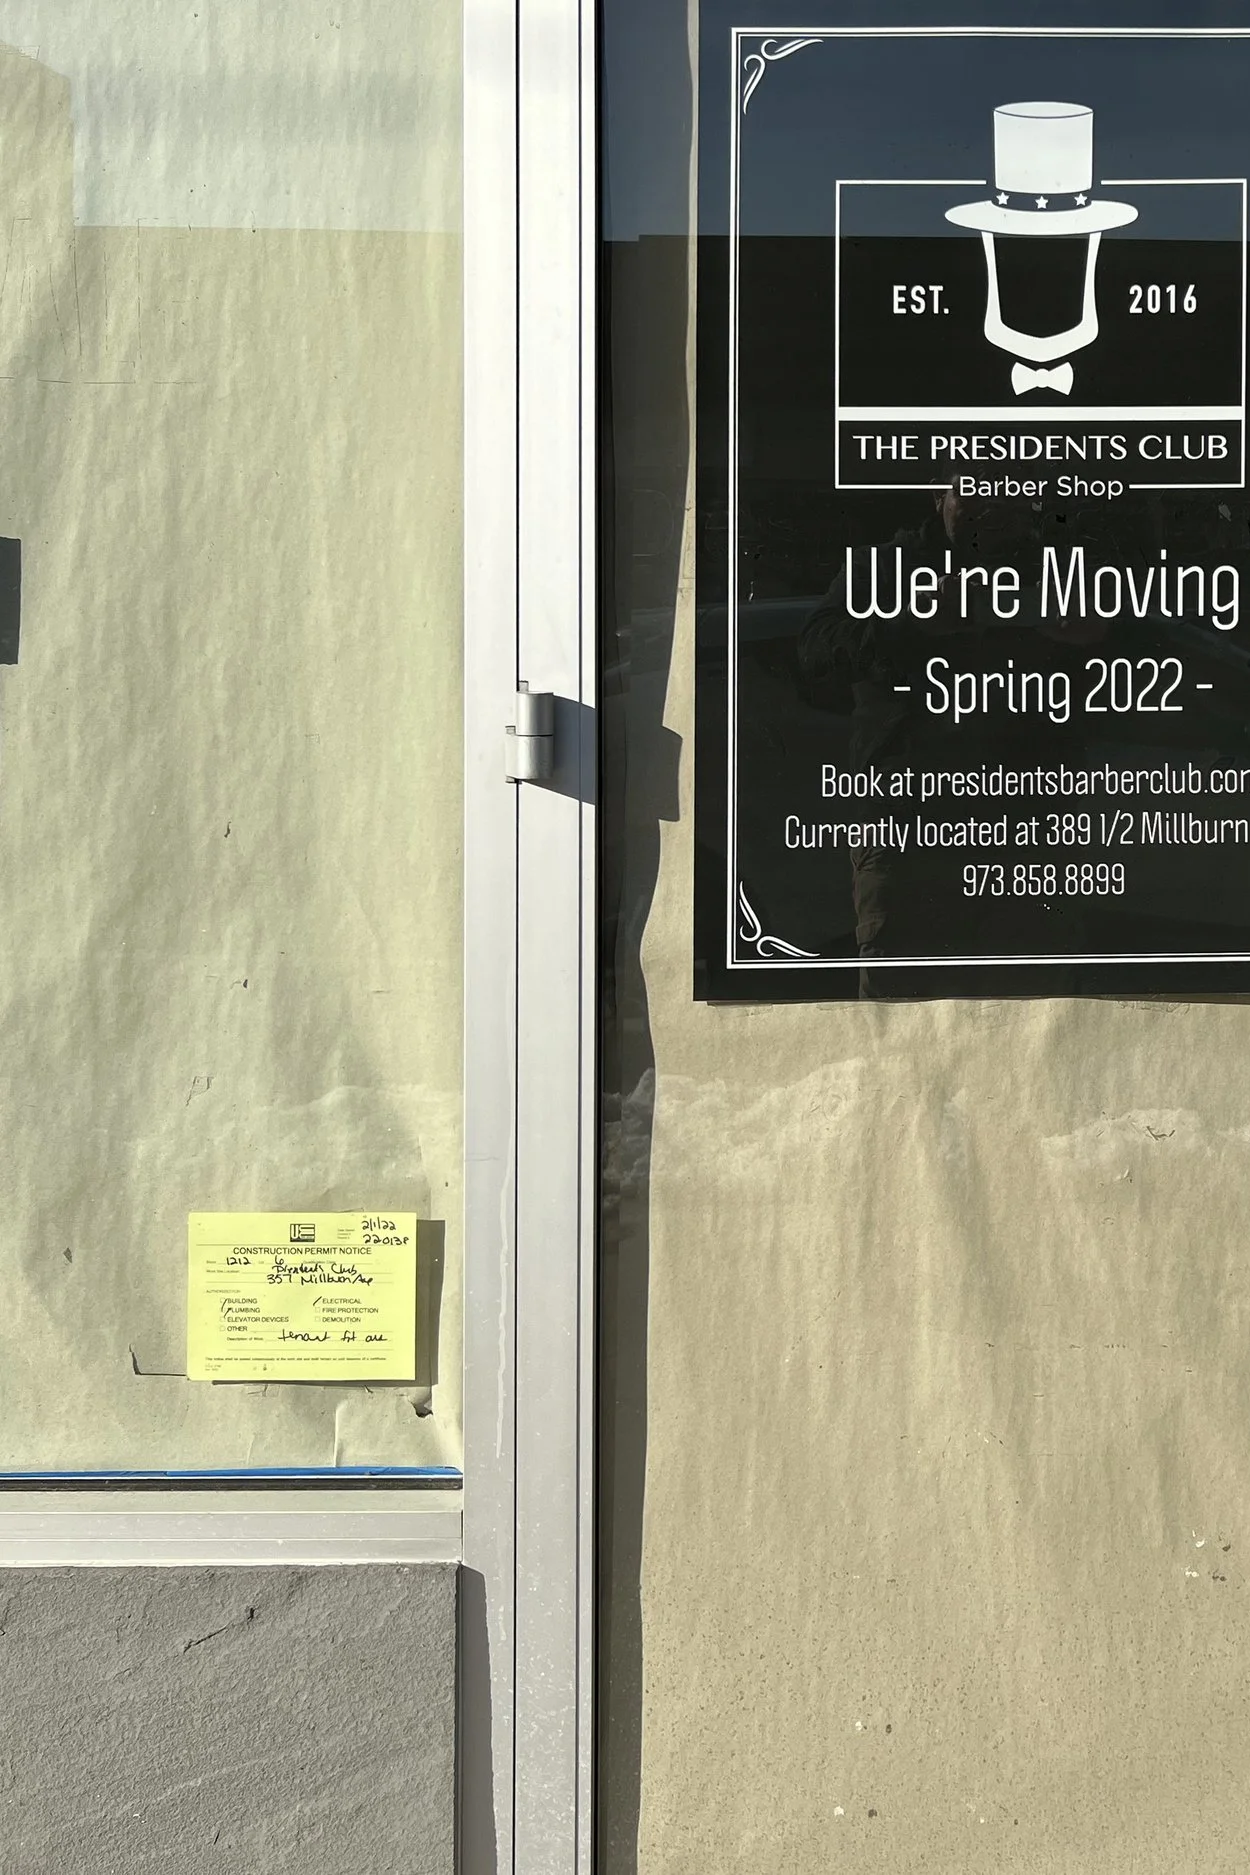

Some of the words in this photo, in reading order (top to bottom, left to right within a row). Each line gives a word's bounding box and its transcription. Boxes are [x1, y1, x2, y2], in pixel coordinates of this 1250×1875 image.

[893, 285, 949, 314] EST.
[1129, 284, 1197, 314] 2016
[852, 435, 919, 460] THE
[931, 435, 1127, 461] PRESIDENTS
[1138, 434, 1228, 460] CLUB
[959, 475, 1048, 497] Barber
[1057, 475, 1124, 500] Shop
[846, 546, 1020, 619] We're
[1040, 546, 1239, 631] Moving
[926, 657, 1070, 724] Spring
[1085, 657, 1183, 713] 2022
[822, 764, 885, 798] Book
[889, 767, 915, 797] at
[785, 815, 909, 853] Currently
[916, 814, 1007, 847] located
[1015, 816, 1040, 846] at
[1046, 813, 1091, 846] 389
[1099, 809, 1134, 847] 1/2
[1141, 811, 1249, 845] Millburn
[963, 863, 1125, 897] 973.858.8899
[226, 1256, 252, 1266] 1212
[233, 1247, 303, 1255] CONSTRUCTION
[304, 1247, 338, 1255] PERMIT
[339, 1247, 372, 1255] NOTICE
[274, 1255, 285, 1265] 6
[266, 1273, 292, 1285] 357
